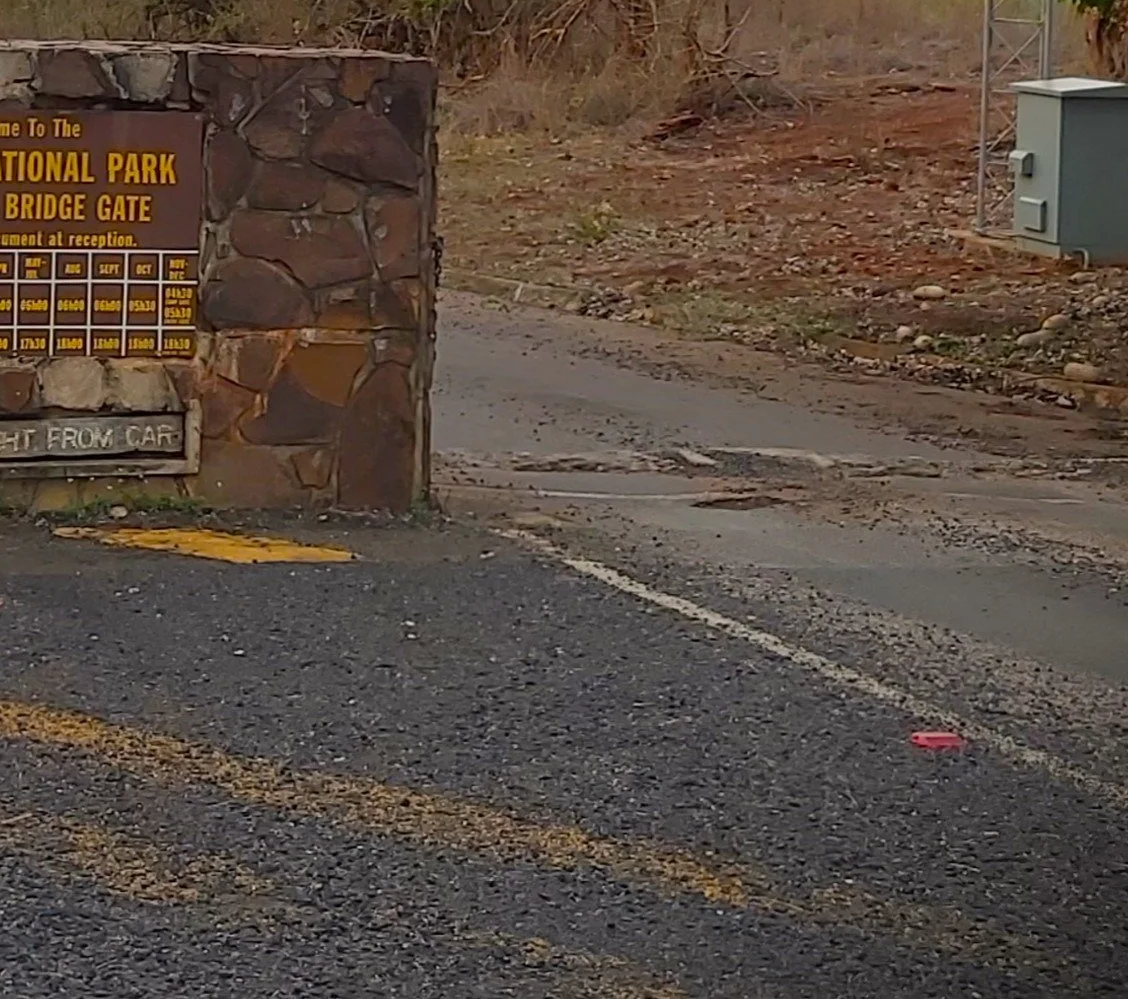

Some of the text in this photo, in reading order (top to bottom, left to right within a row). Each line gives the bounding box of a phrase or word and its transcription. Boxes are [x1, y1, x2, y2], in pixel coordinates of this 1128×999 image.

[28, 117, 45, 138] To
[53, 117, 81, 138] The
[107, 152, 177, 184] PARK
[5, 193, 86, 220] BRIDGE
[97, 194, 152, 222] GATE
[48, 231, 63, 247] at
[69, 231, 138, 249] reception.
[99, 264, 119, 274] SEPT
[136, 264, 152, 275] OCT
[20, 338, 46, 350] 17h30
[47, 426, 114, 450] FROM
[125, 424, 178, 447] CAR
